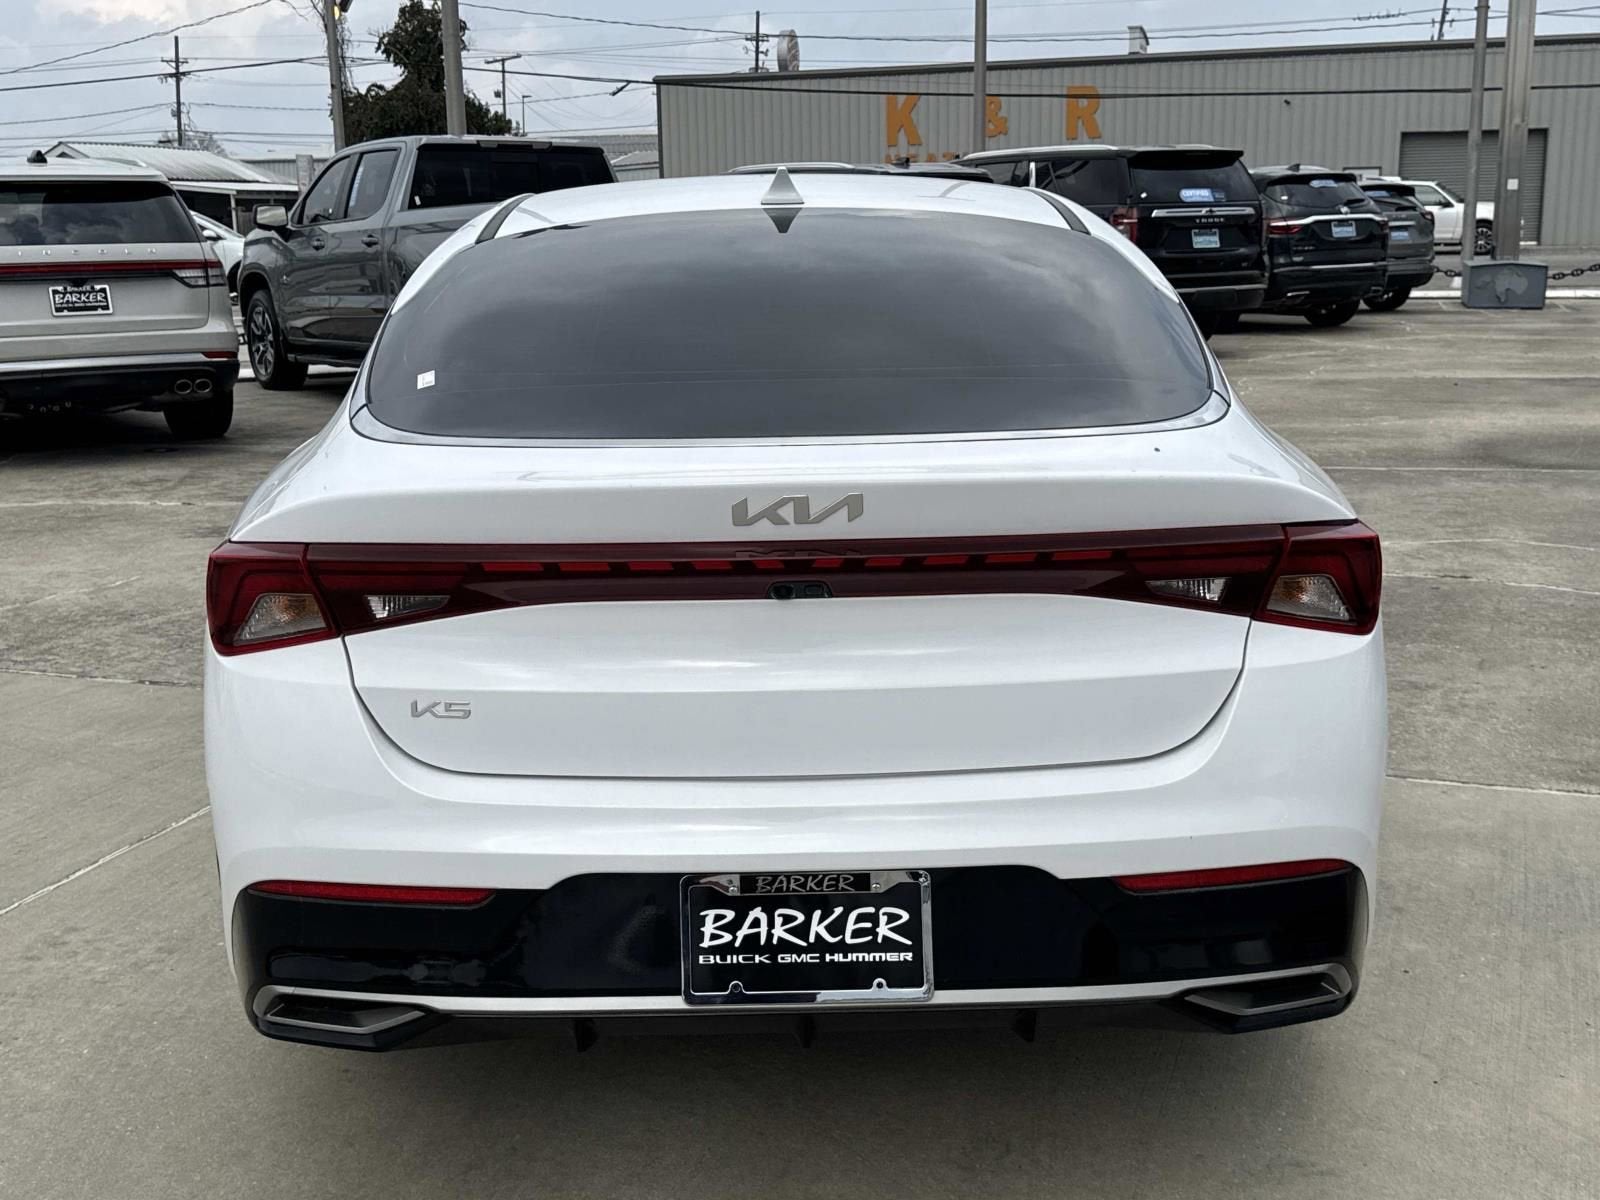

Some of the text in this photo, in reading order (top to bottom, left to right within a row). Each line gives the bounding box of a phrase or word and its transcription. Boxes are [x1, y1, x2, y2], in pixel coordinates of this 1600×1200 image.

[885, 92, 922, 146] K
[1065, 85, 1101, 140] R
[55, 292, 106, 304] BARKER
[732, 492, 864, 527] KIA
[411, 699, 472, 719] K5
[755, 874, 855, 893] BARKER
[699, 906, 913, 948] BARKER
[698, 951, 913, 964] BUICK GMC HUMMER
